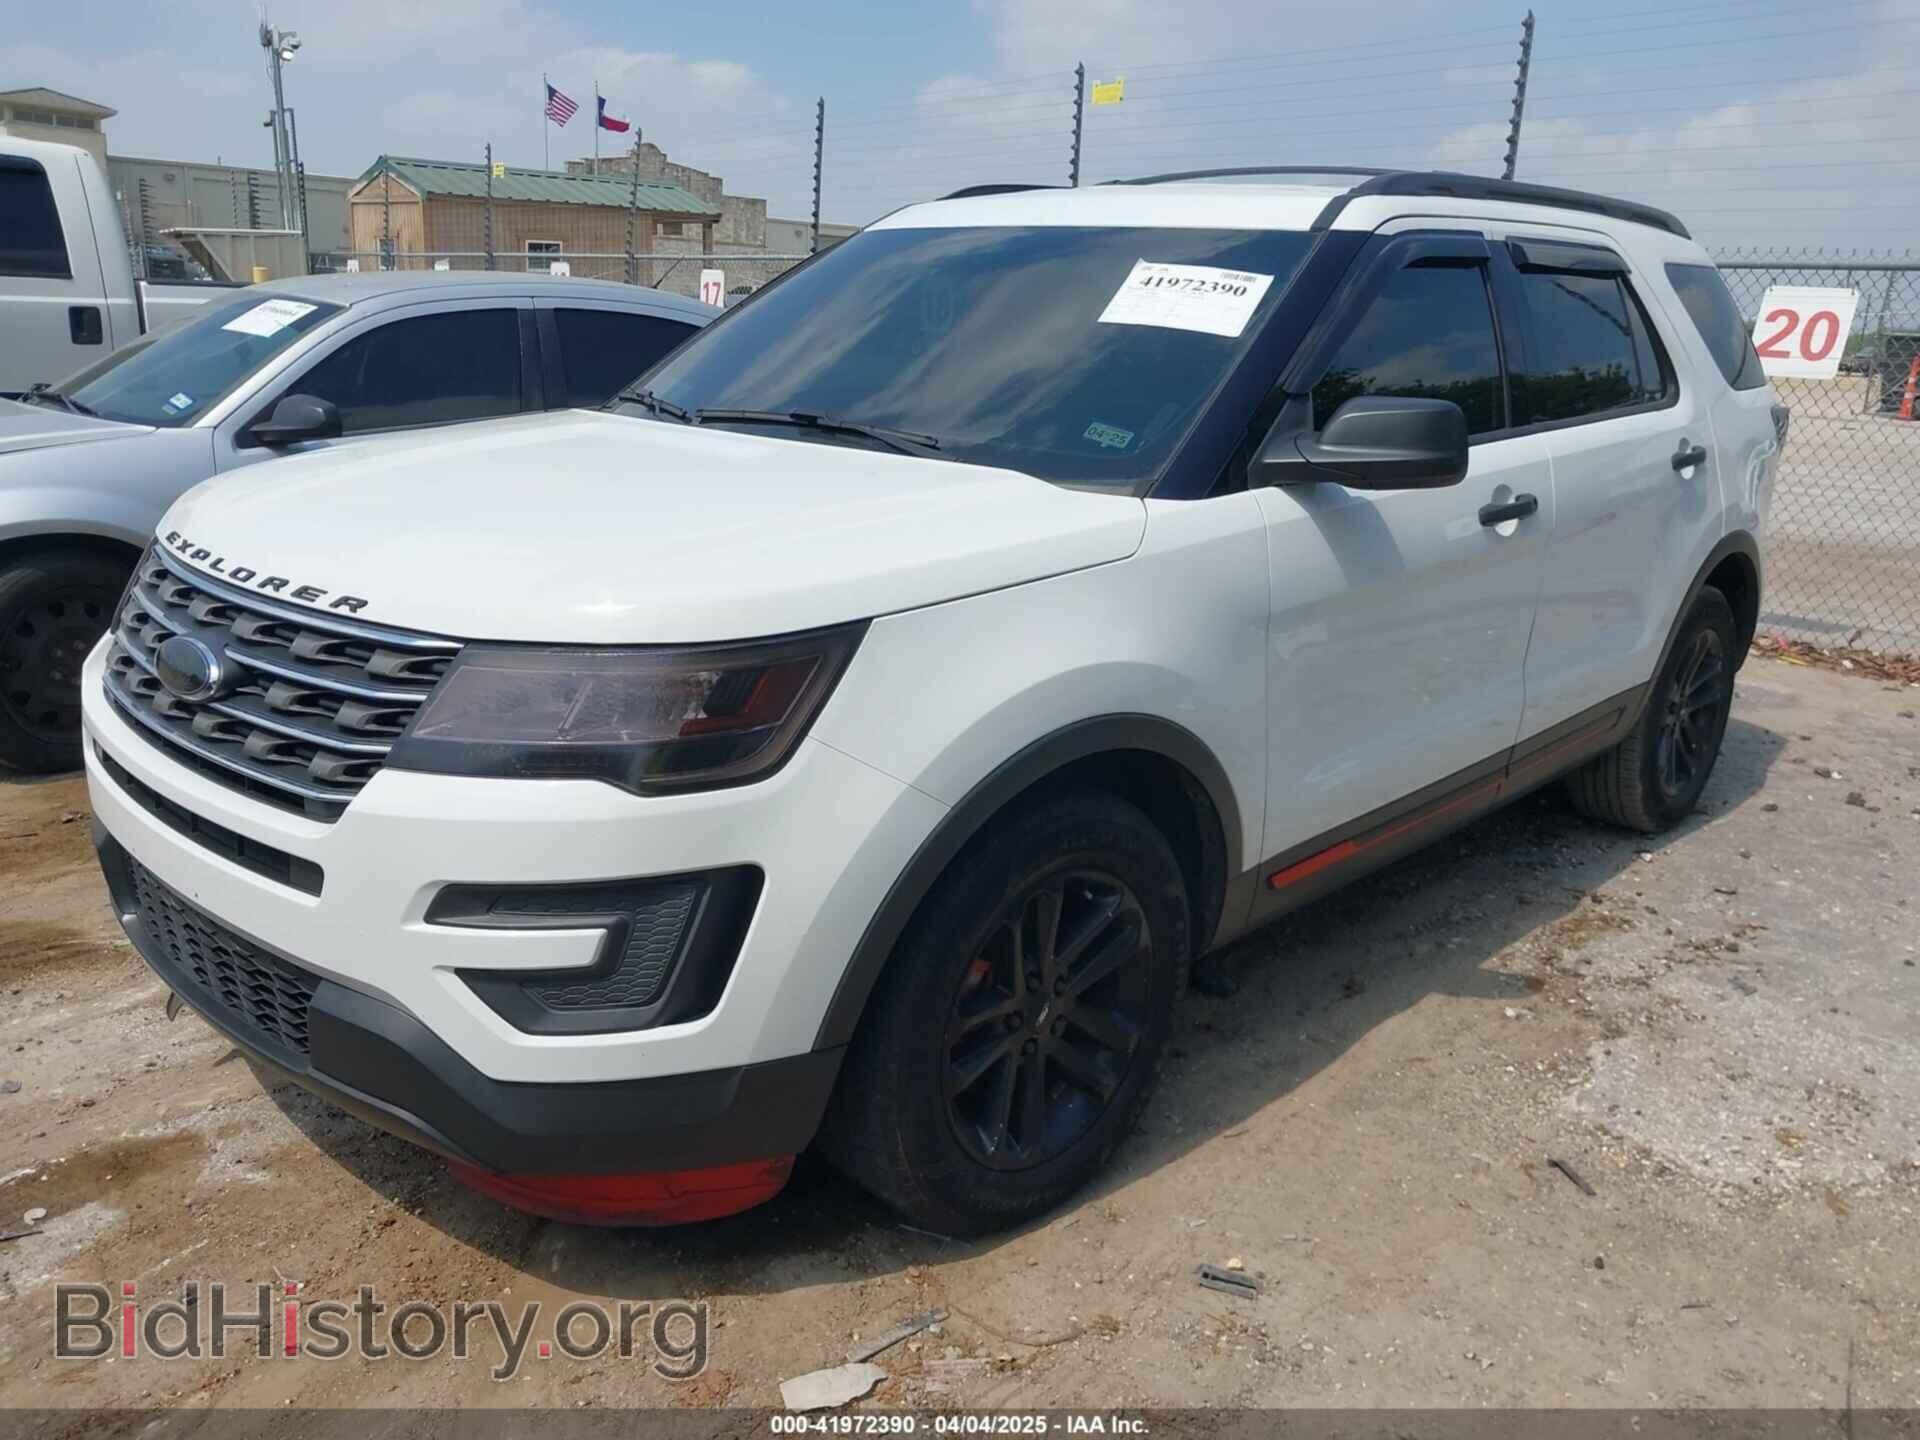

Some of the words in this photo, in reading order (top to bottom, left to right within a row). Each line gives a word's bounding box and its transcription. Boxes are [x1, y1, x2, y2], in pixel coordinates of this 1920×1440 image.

[703, 281, 721, 306] 17
[1139, 274, 1248, 297] 41972390
[1755, 308, 1840, 362] 20
[165, 531, 368, 614] EXPLORER
